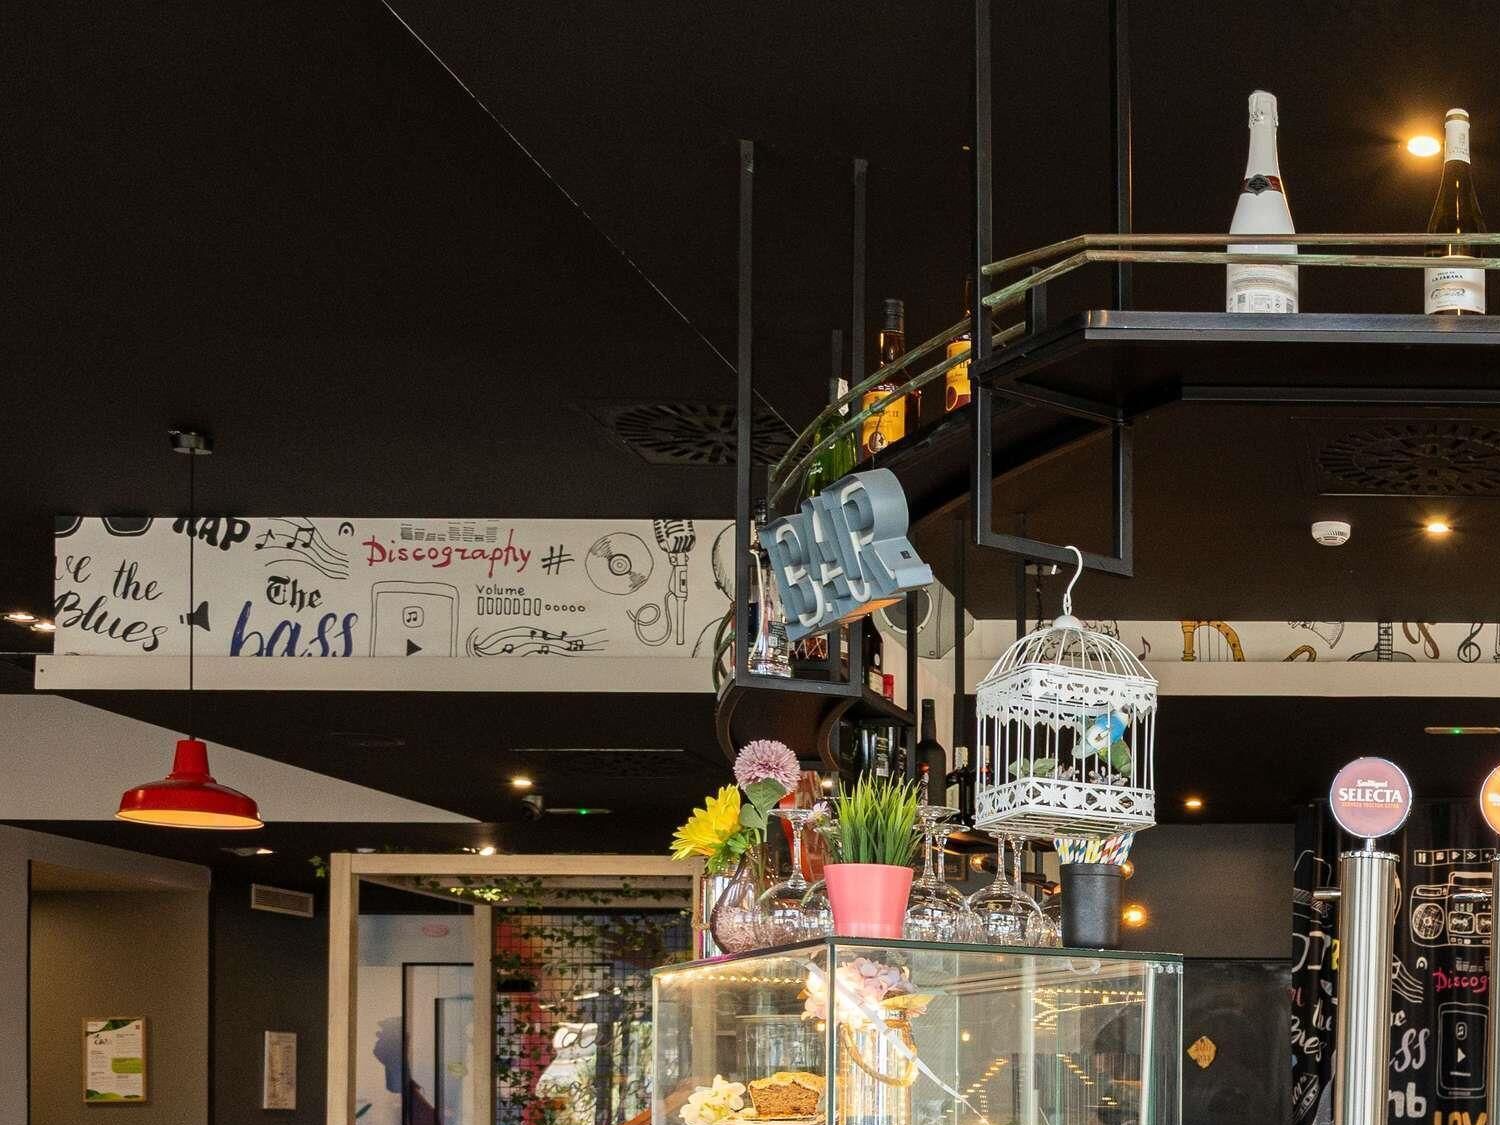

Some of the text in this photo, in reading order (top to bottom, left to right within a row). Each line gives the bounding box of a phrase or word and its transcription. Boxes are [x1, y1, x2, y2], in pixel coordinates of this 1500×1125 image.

[362, 529, 532, 578] Discography
[113, 559, 164, 601] the
[266, 575, 324, 613] The
[476, 584, 526, 596] Volume
[54, 590, 169, 652] Blues
[1338, 787, 1404, 803] SELECTA
